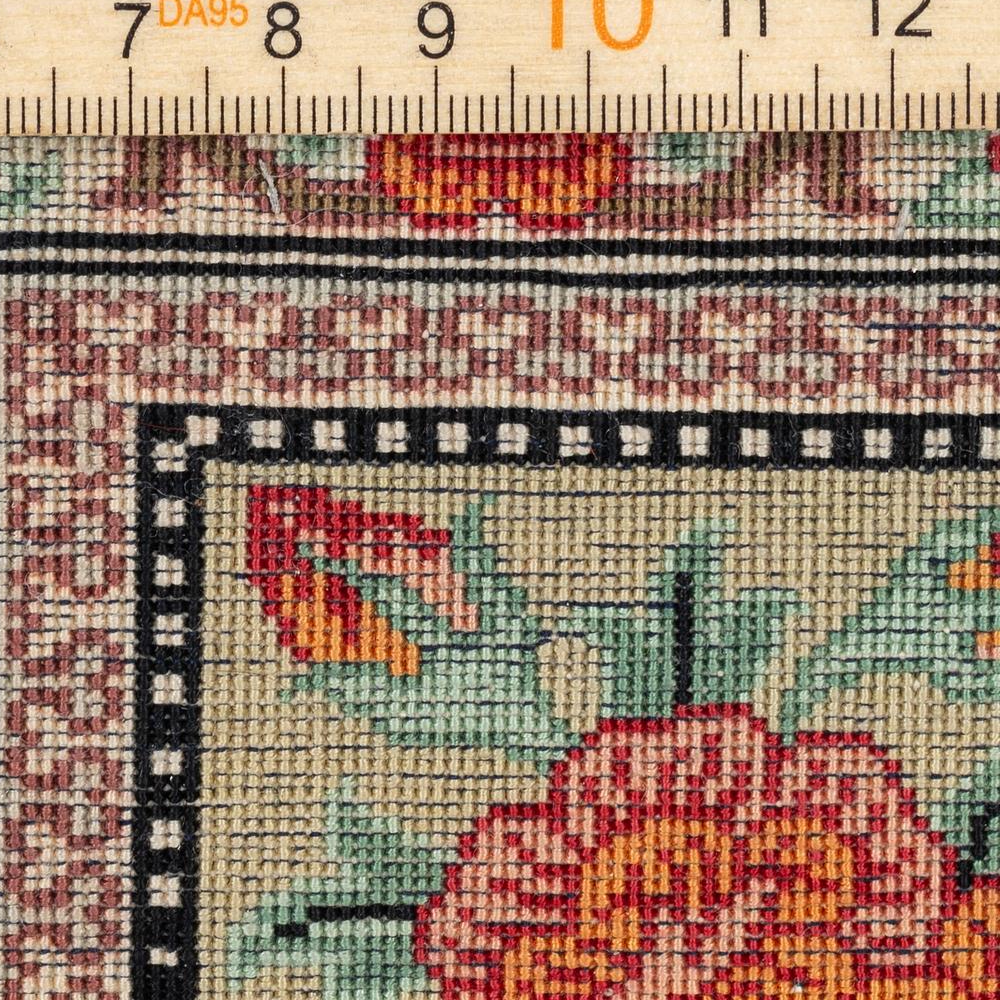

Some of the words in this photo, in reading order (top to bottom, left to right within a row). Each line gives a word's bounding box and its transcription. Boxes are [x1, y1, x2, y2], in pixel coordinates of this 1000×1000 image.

[113, 2, 152, 60] 7
[263, 1, 304, 60] 8
[416, 1, 456, 60] 9
